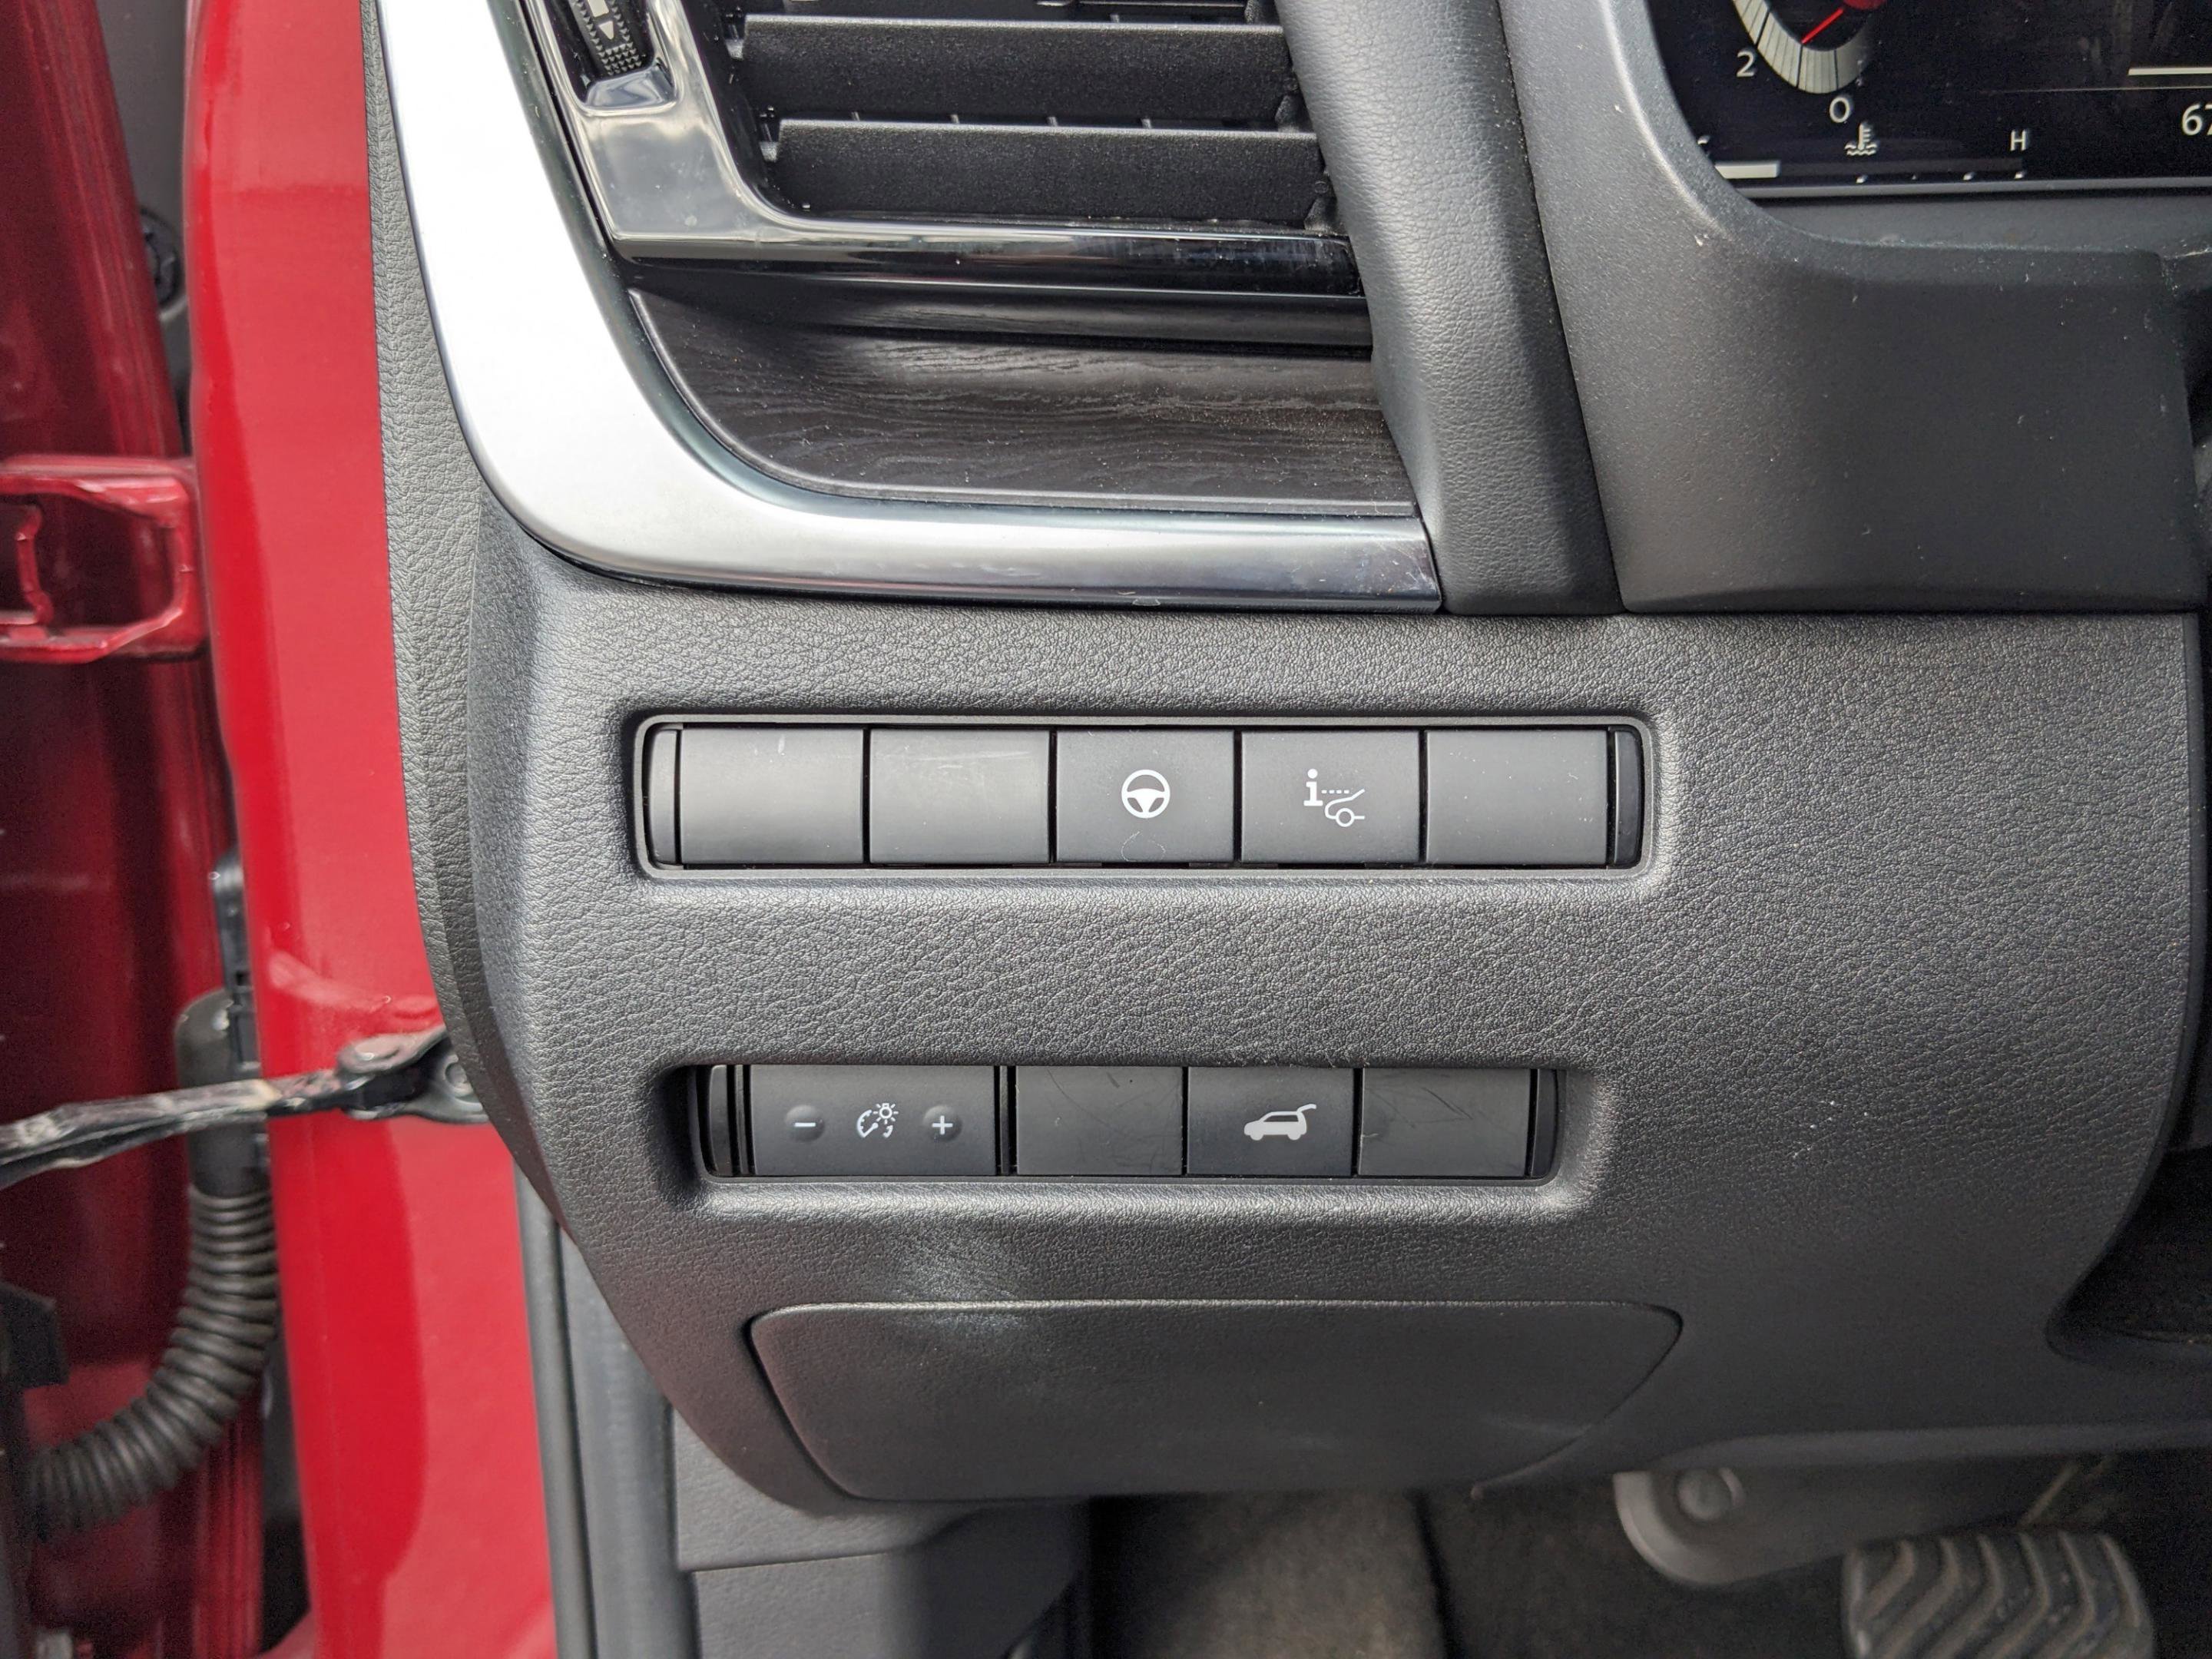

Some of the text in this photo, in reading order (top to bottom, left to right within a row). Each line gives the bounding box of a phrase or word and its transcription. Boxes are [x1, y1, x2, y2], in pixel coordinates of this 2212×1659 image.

[1736, 50, 1756, 78] 2
[1829, 96, 1850, 123] 0
[2010, 129, 2027, 151] H
